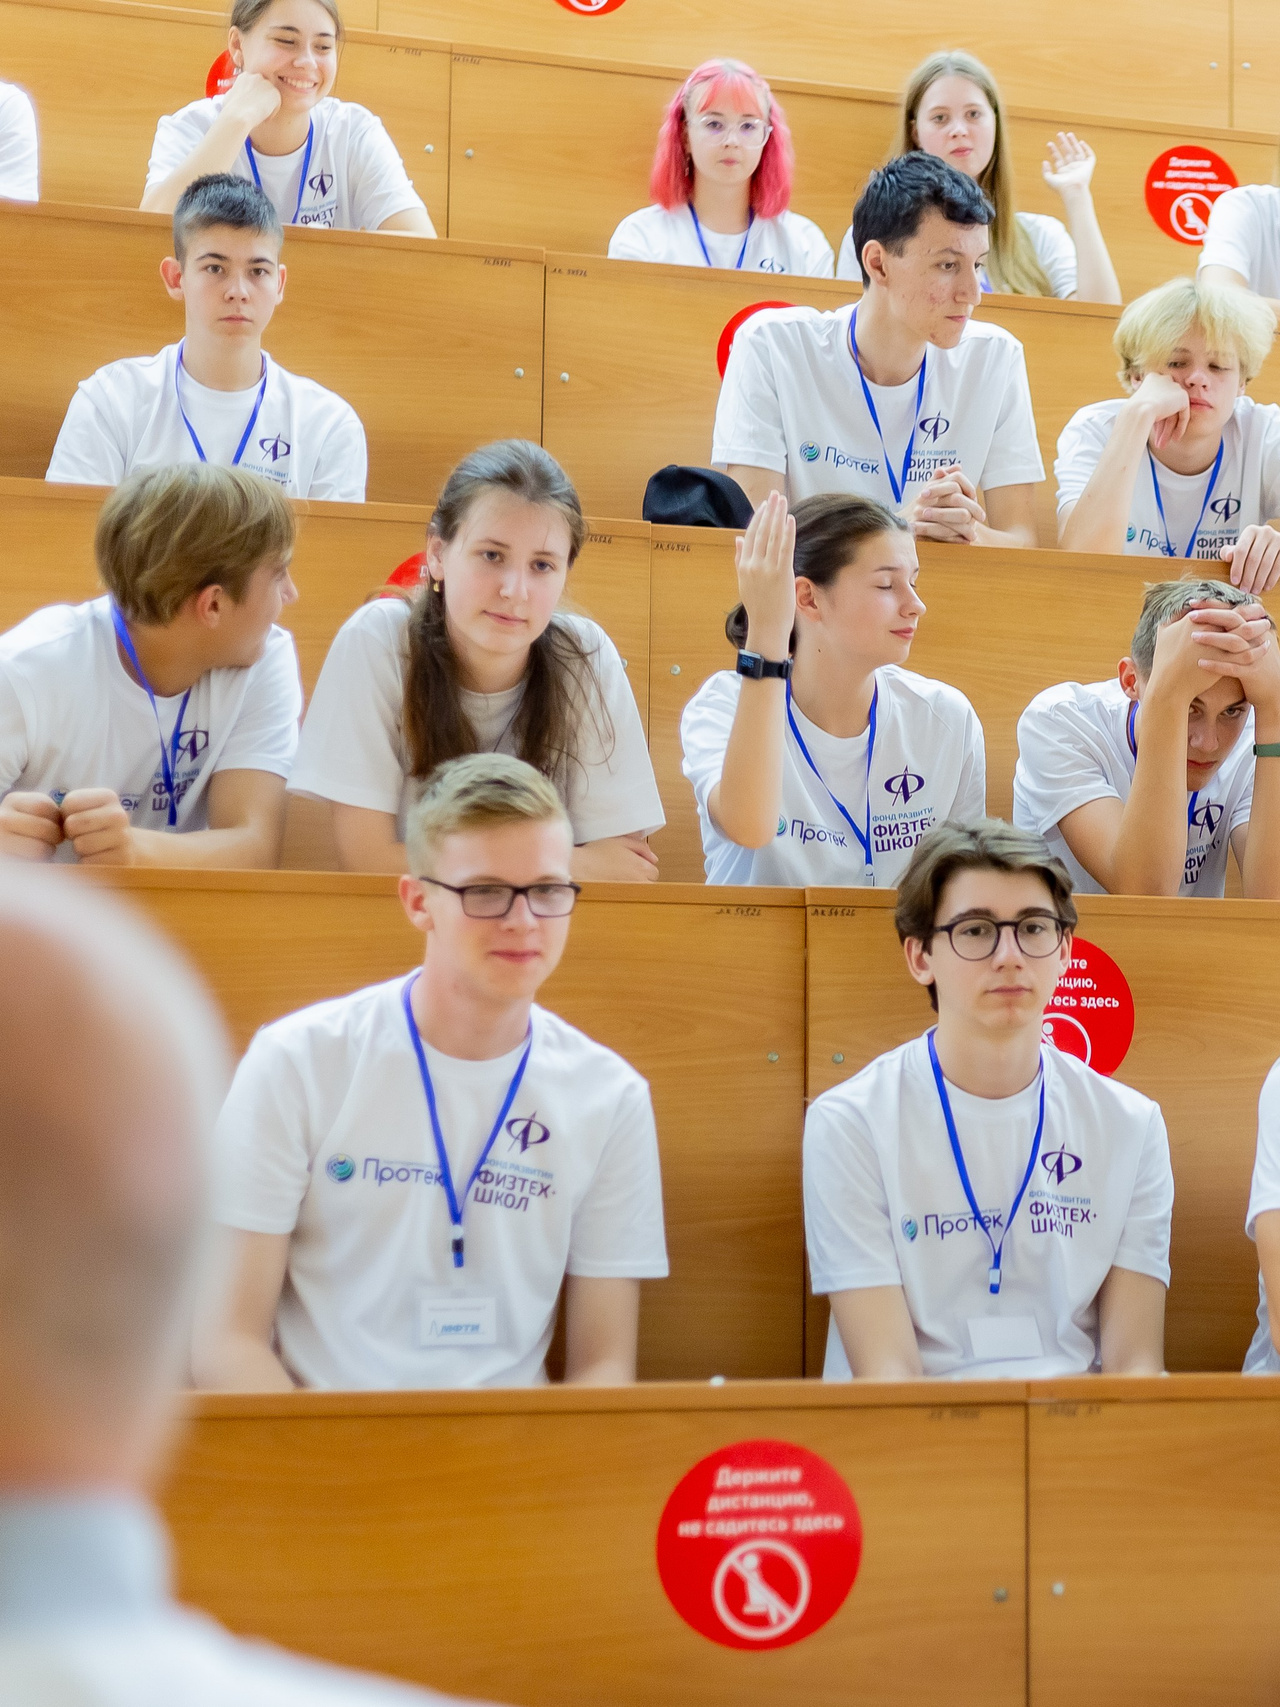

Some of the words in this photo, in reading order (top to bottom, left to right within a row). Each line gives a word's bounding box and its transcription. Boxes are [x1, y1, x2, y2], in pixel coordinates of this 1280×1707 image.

[825, 446, 881, 475] Протек
[906, 471, 935, 483] ШКО
[791, 819, 848, 848] Протек
[1080, 996, 1120, 1009] здесь
[363, 1157, 445, 1187] Протек
[473, 1186, 530, 1212] ШКОЛ
[925, 1213, 1004, 1240] Протек
